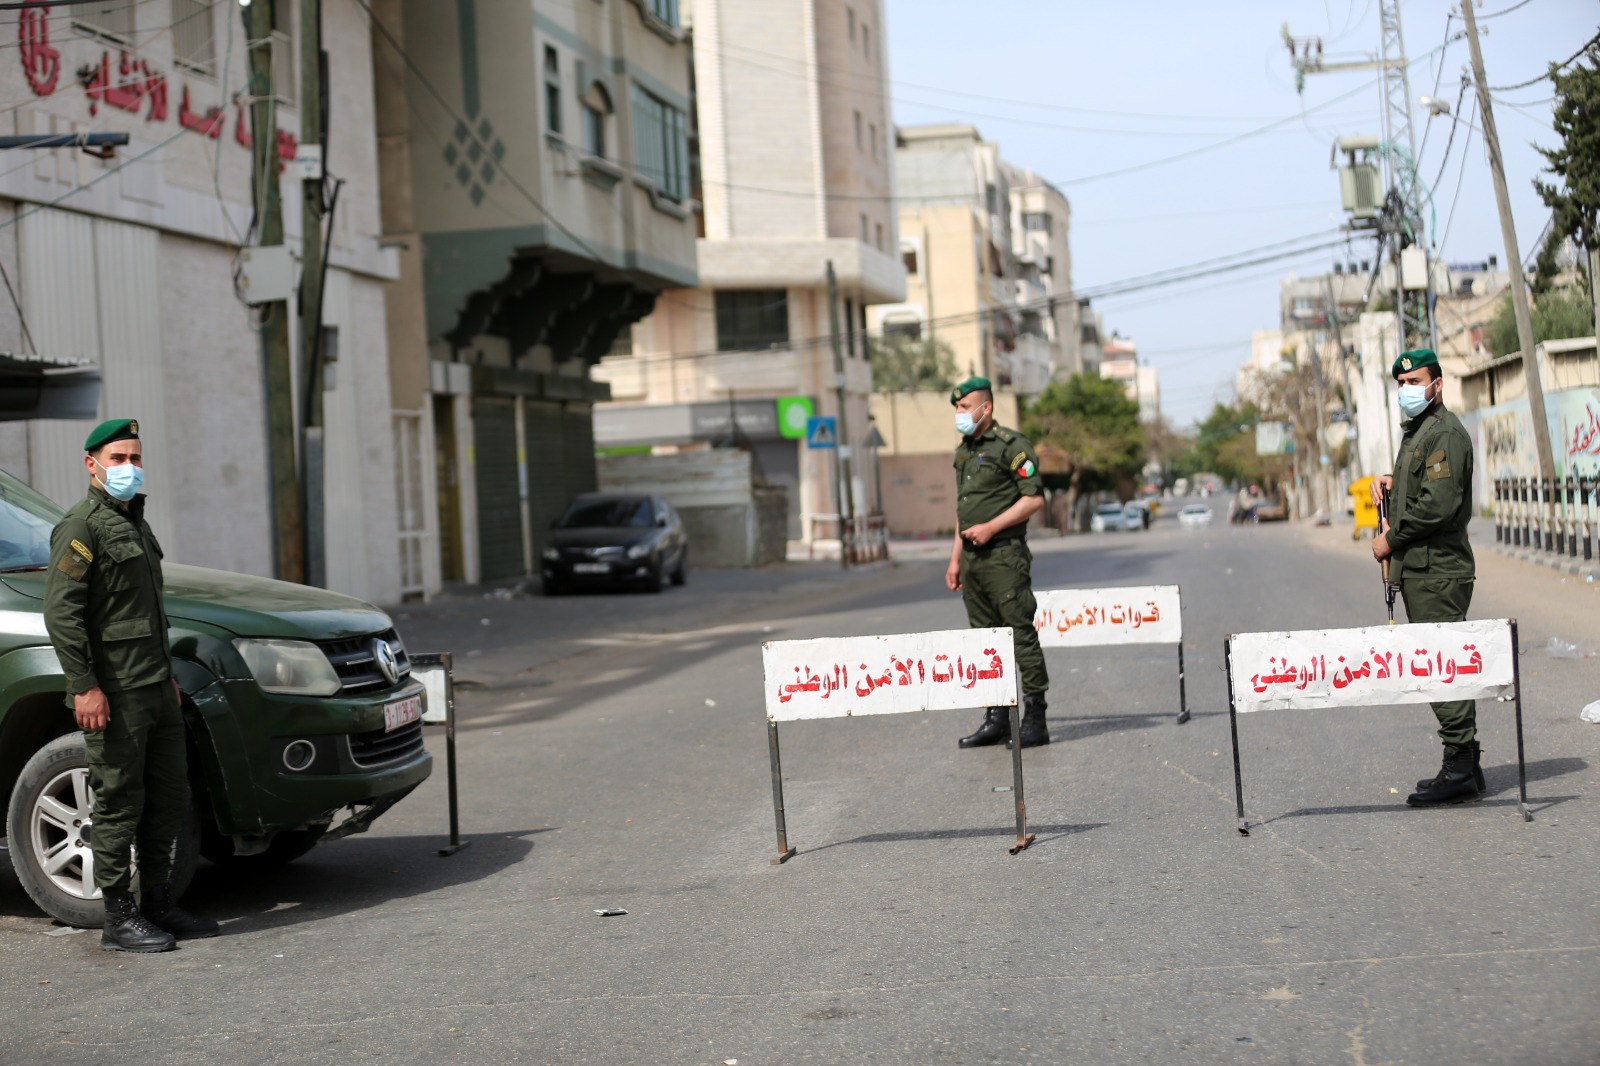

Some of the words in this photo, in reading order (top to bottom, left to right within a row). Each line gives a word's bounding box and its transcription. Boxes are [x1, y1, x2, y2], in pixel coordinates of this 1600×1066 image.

[1109, 601, 1161, 629] قوات
[854, 655, 926, 698] الأمن
[931, 647, 1004, 690] قوات
[1332, 647, 1404, 690] الأمن
[1409, 643, 1483, 685] قوات
